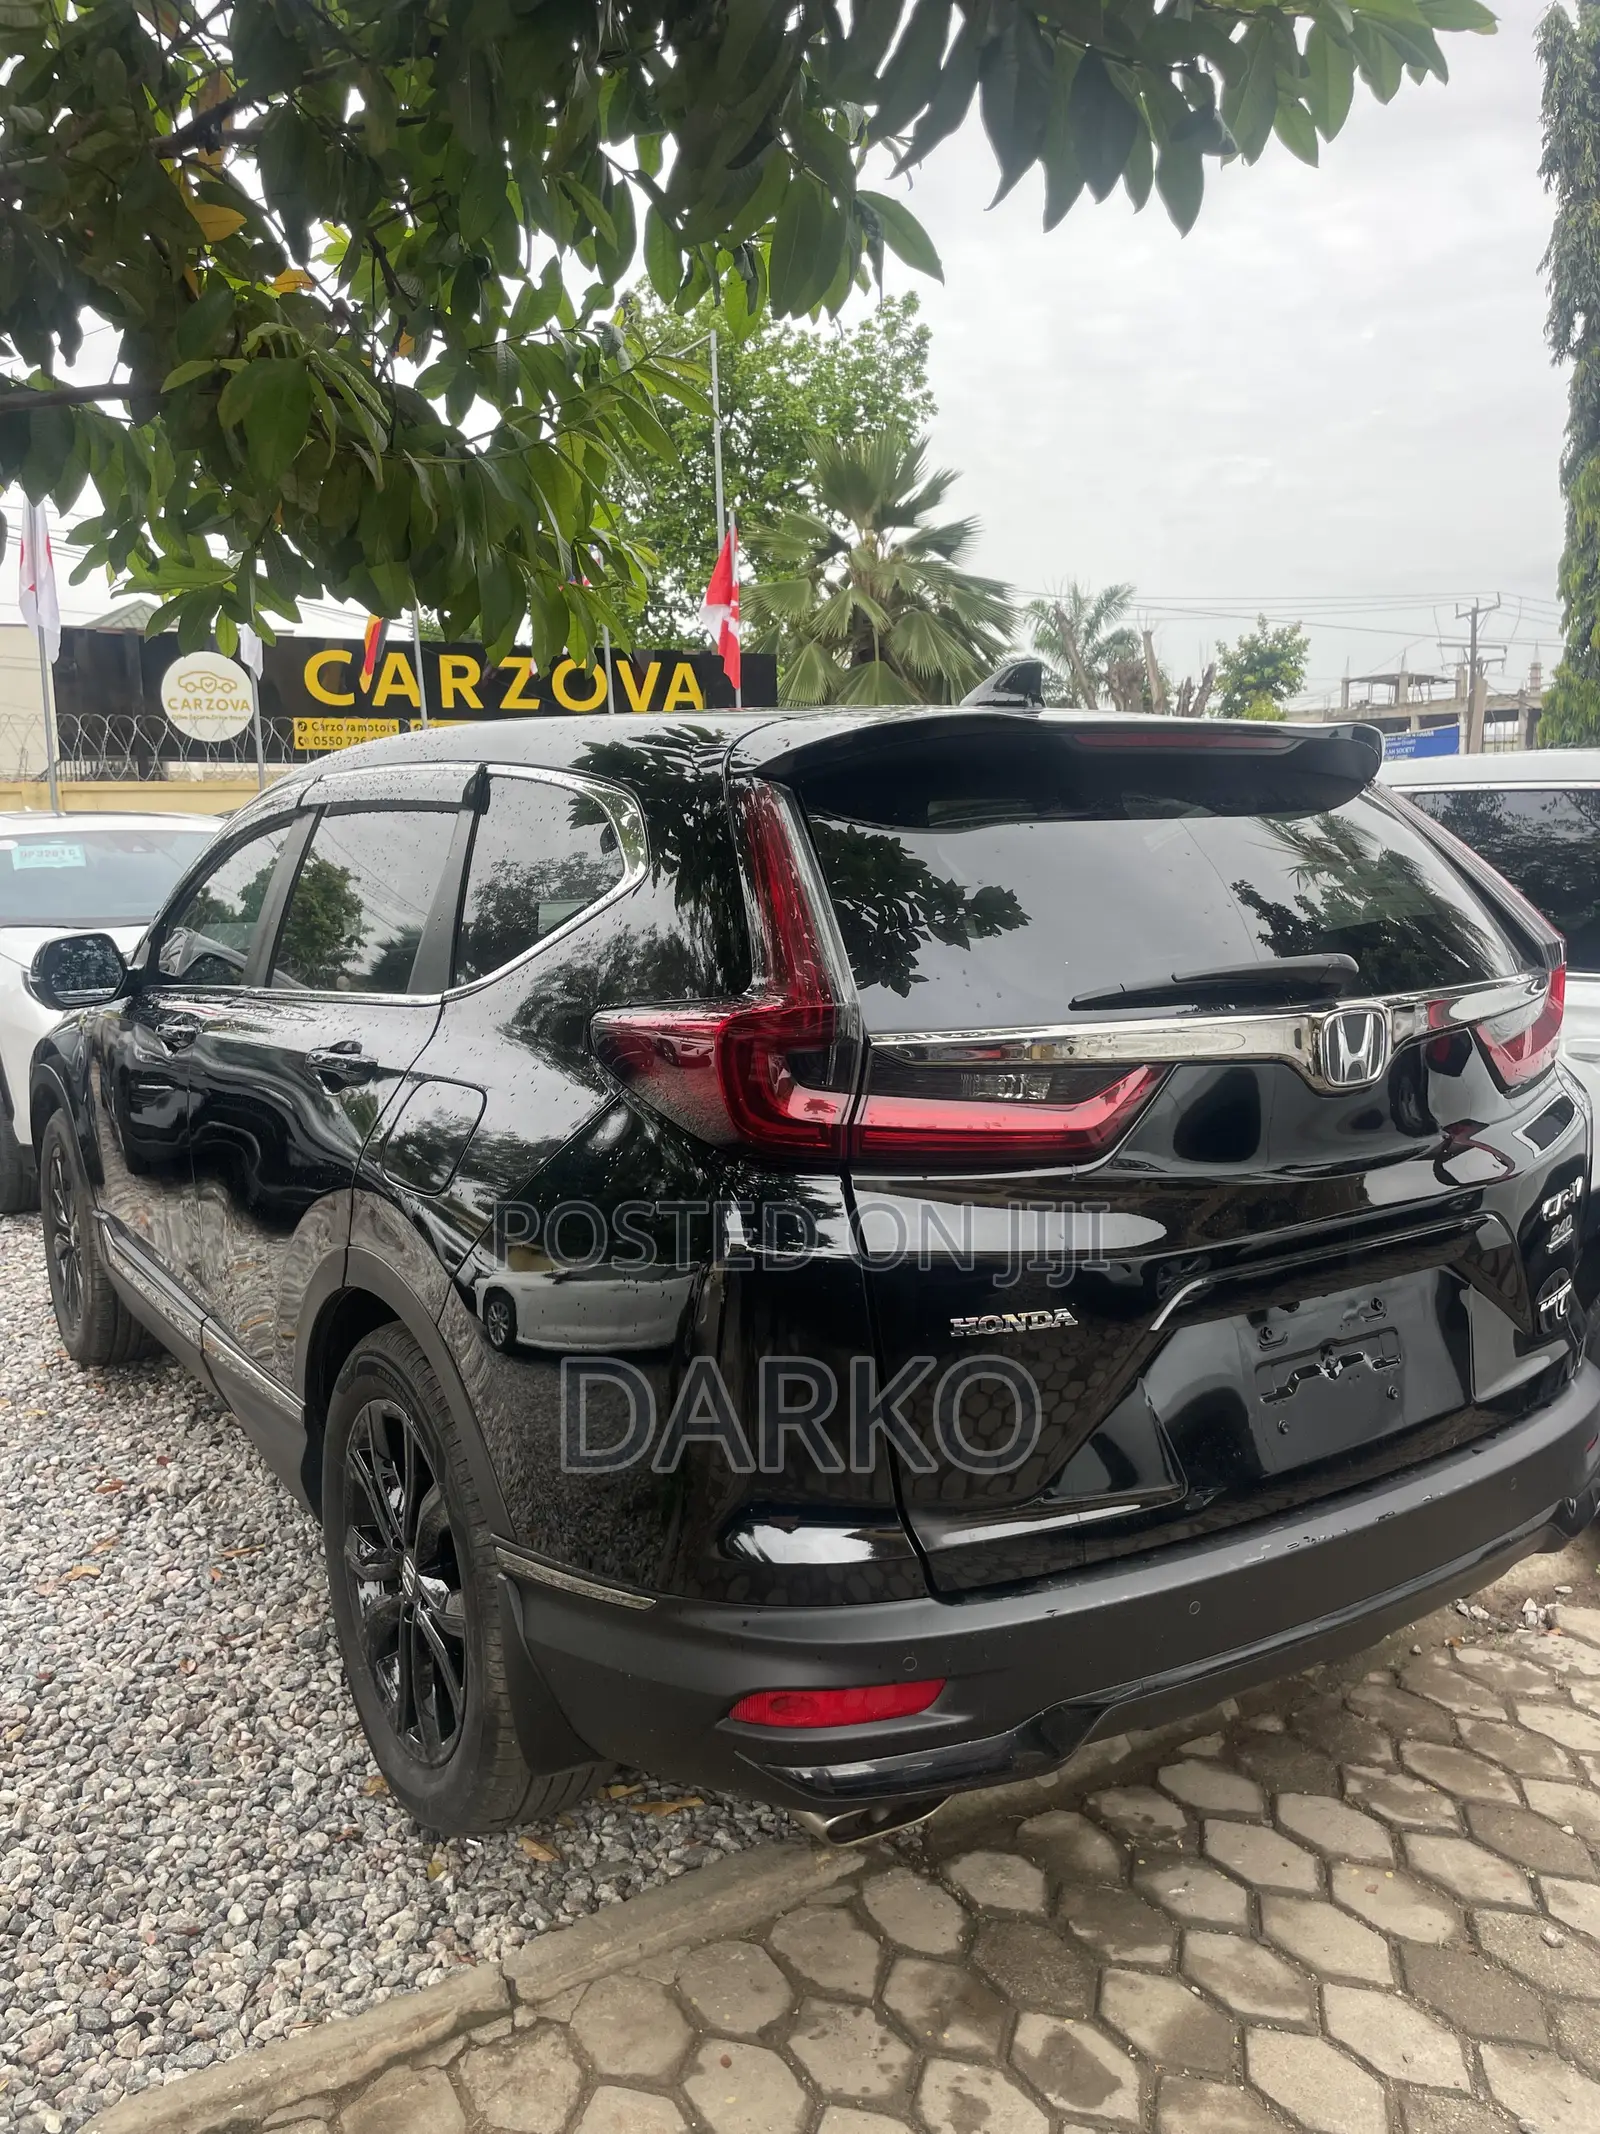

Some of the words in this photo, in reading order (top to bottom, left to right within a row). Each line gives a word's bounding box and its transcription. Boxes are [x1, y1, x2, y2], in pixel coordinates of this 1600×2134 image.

[303, 650, 705, 713] CARZOVA
[167, 698, 251, 711] CARZOVA
[313, 736, 343, 746] 0550
[1551, 1214, 1573, 1241] 240
[949, 1307, 1079, 1338] HONDA
